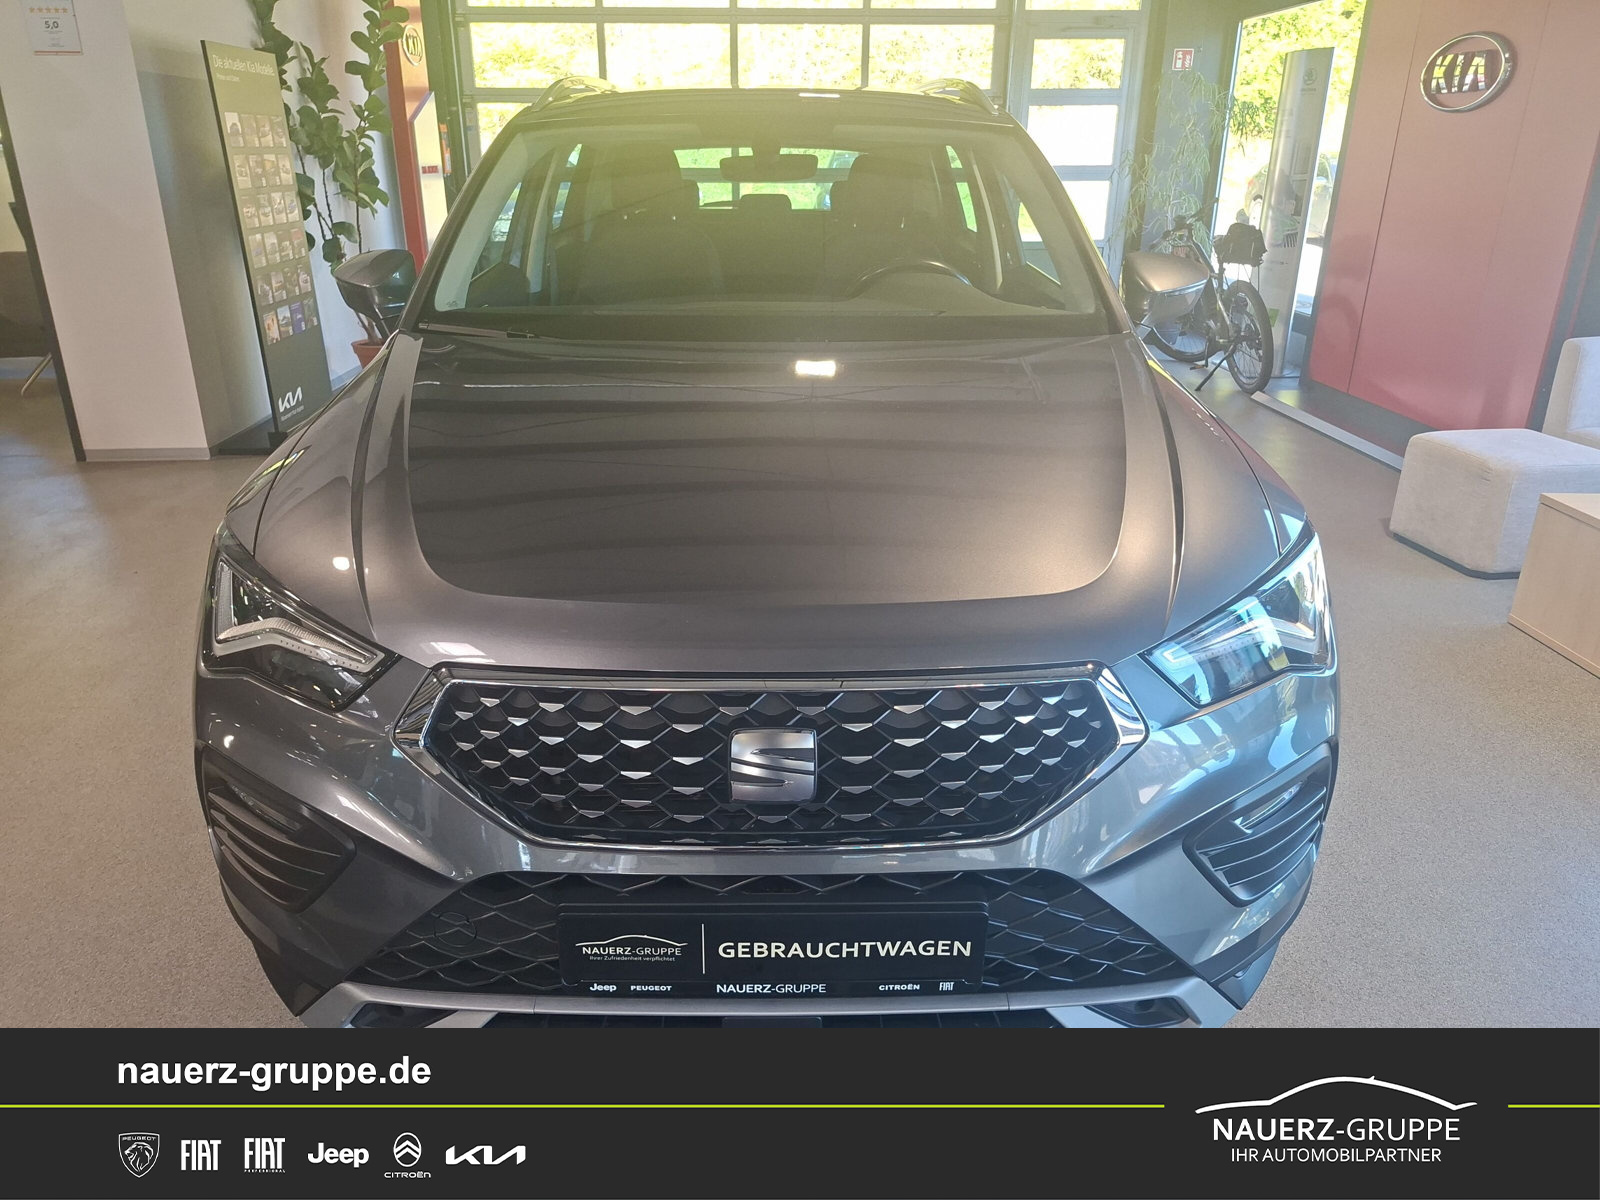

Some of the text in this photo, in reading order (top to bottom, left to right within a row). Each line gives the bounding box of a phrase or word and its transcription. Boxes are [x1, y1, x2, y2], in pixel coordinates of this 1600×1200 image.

[44, 20, 59, 30] 5,0
[1431, 51, 1487, 94] KIA
[278, 386, 303, 413] KIA
[582, 946, 682, 956] NAUERZ-GRUPPE
[718, 940, 972, 959] GEBRAUCHTWAGEN
[589, 983, 617, 993] Jeep
[716, 983, 827, 994] NAUERZ-GRUPPE
[878, 983, 921, 991] CITROËN
[938, 981, 955, 992] FIAT
